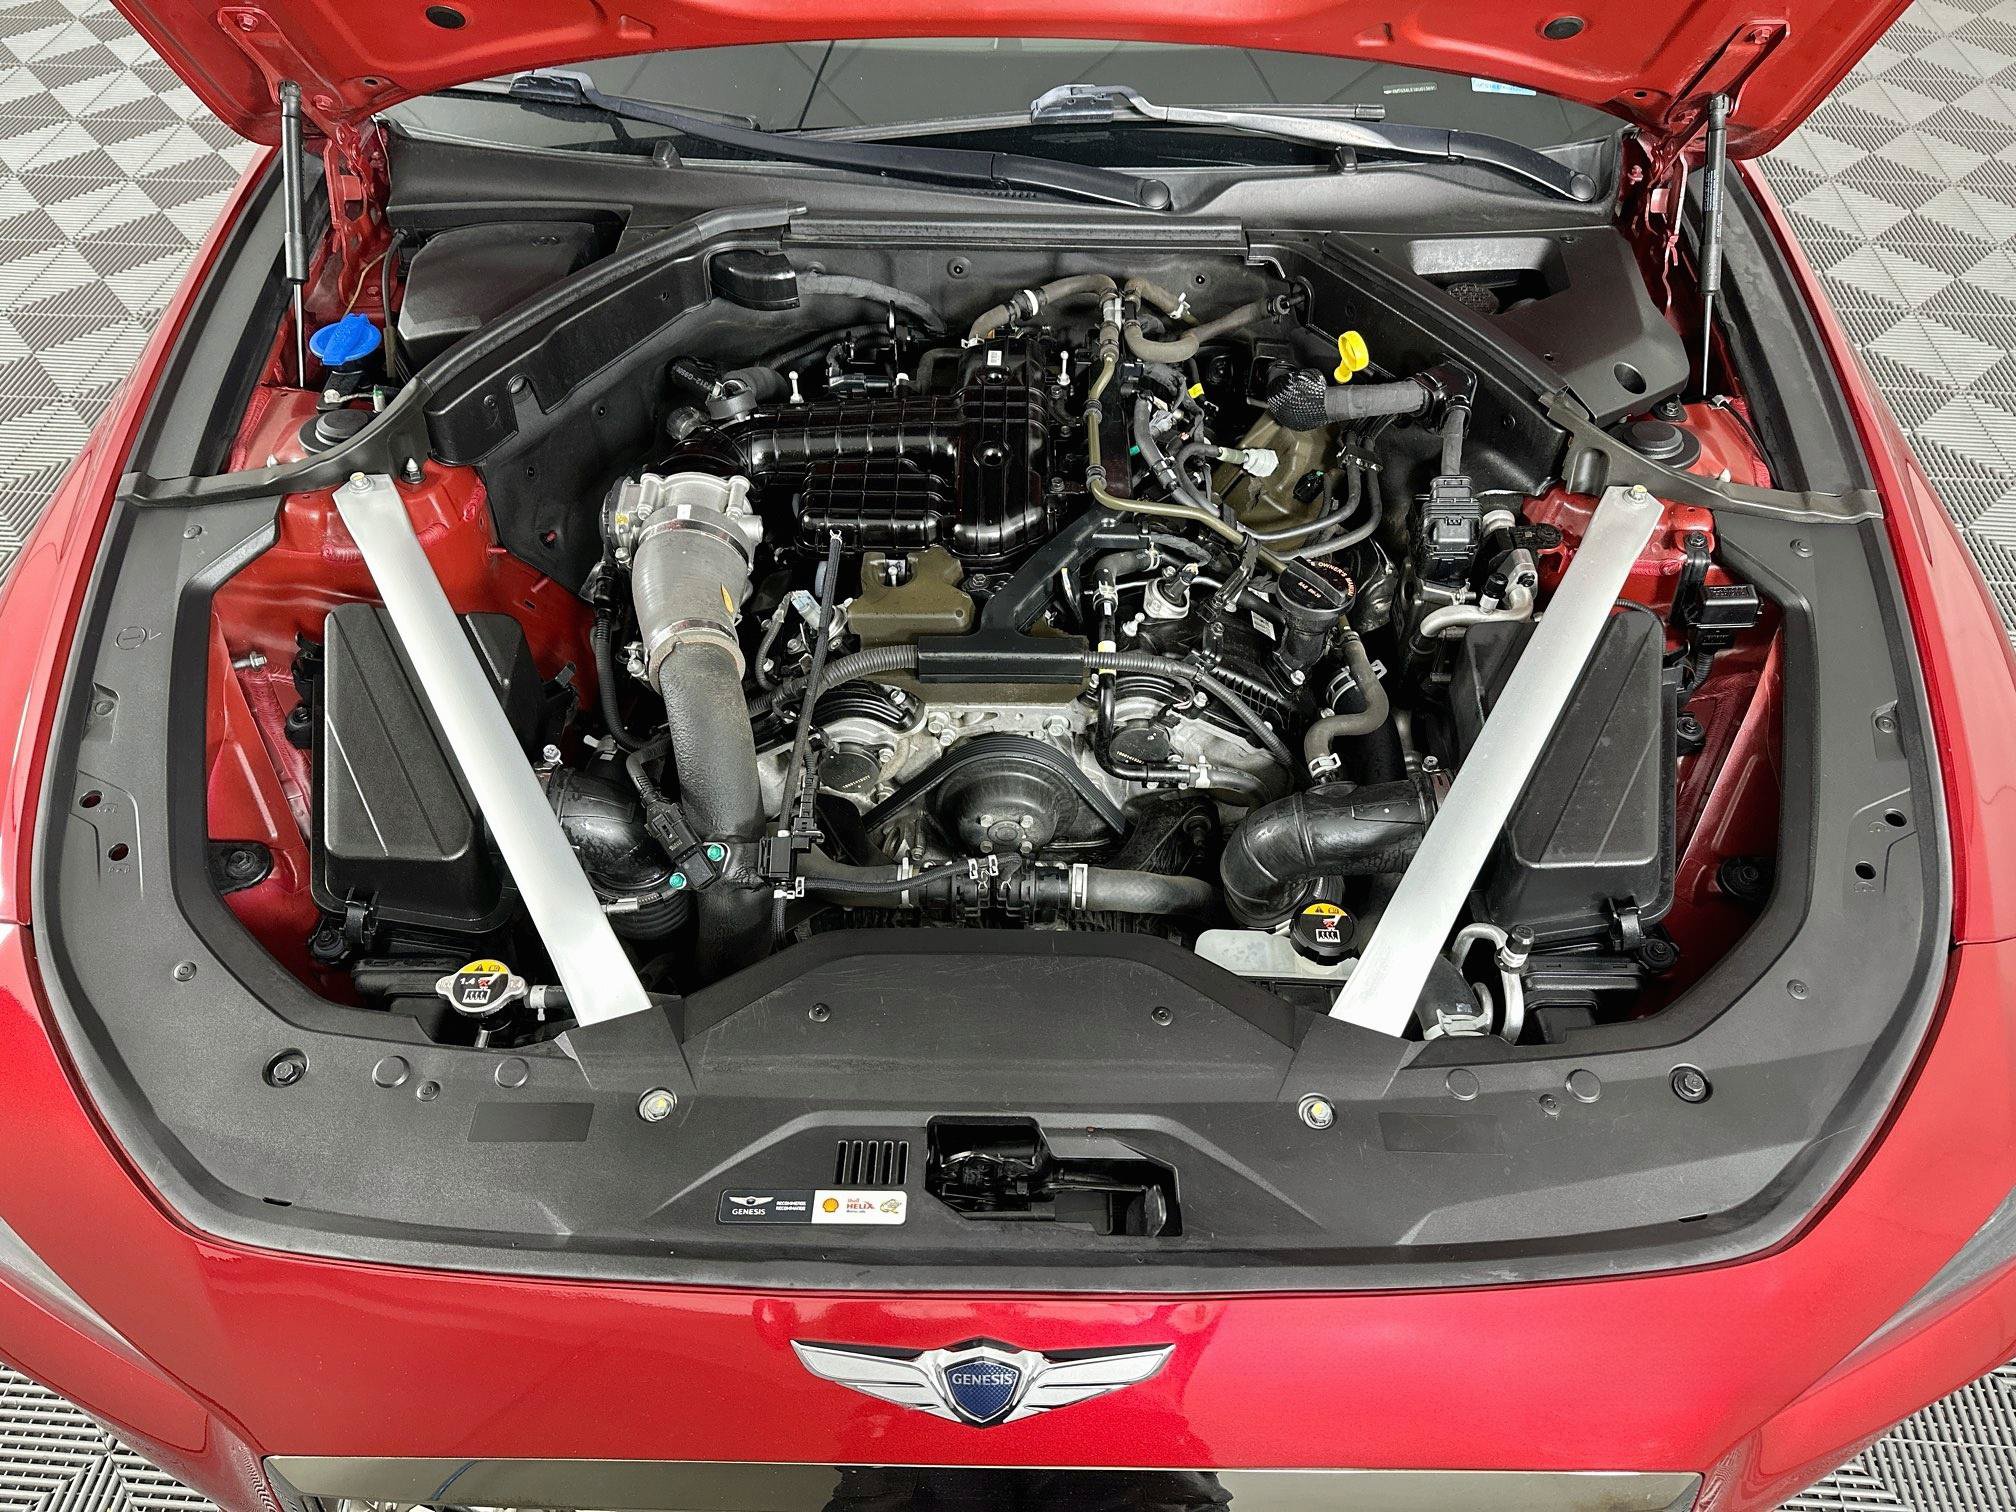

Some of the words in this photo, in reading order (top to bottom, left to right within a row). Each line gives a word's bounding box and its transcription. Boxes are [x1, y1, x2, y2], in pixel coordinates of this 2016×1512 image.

[1318, 561, 1348, 578] OWNER'S
[460, 977, 476, 985] 1.4
[846, 1201, 875, 1210] HELIX
[732, 1208, 767, 1216] GENESIS
[951, 1373, 1013, 1386] GENESIS
